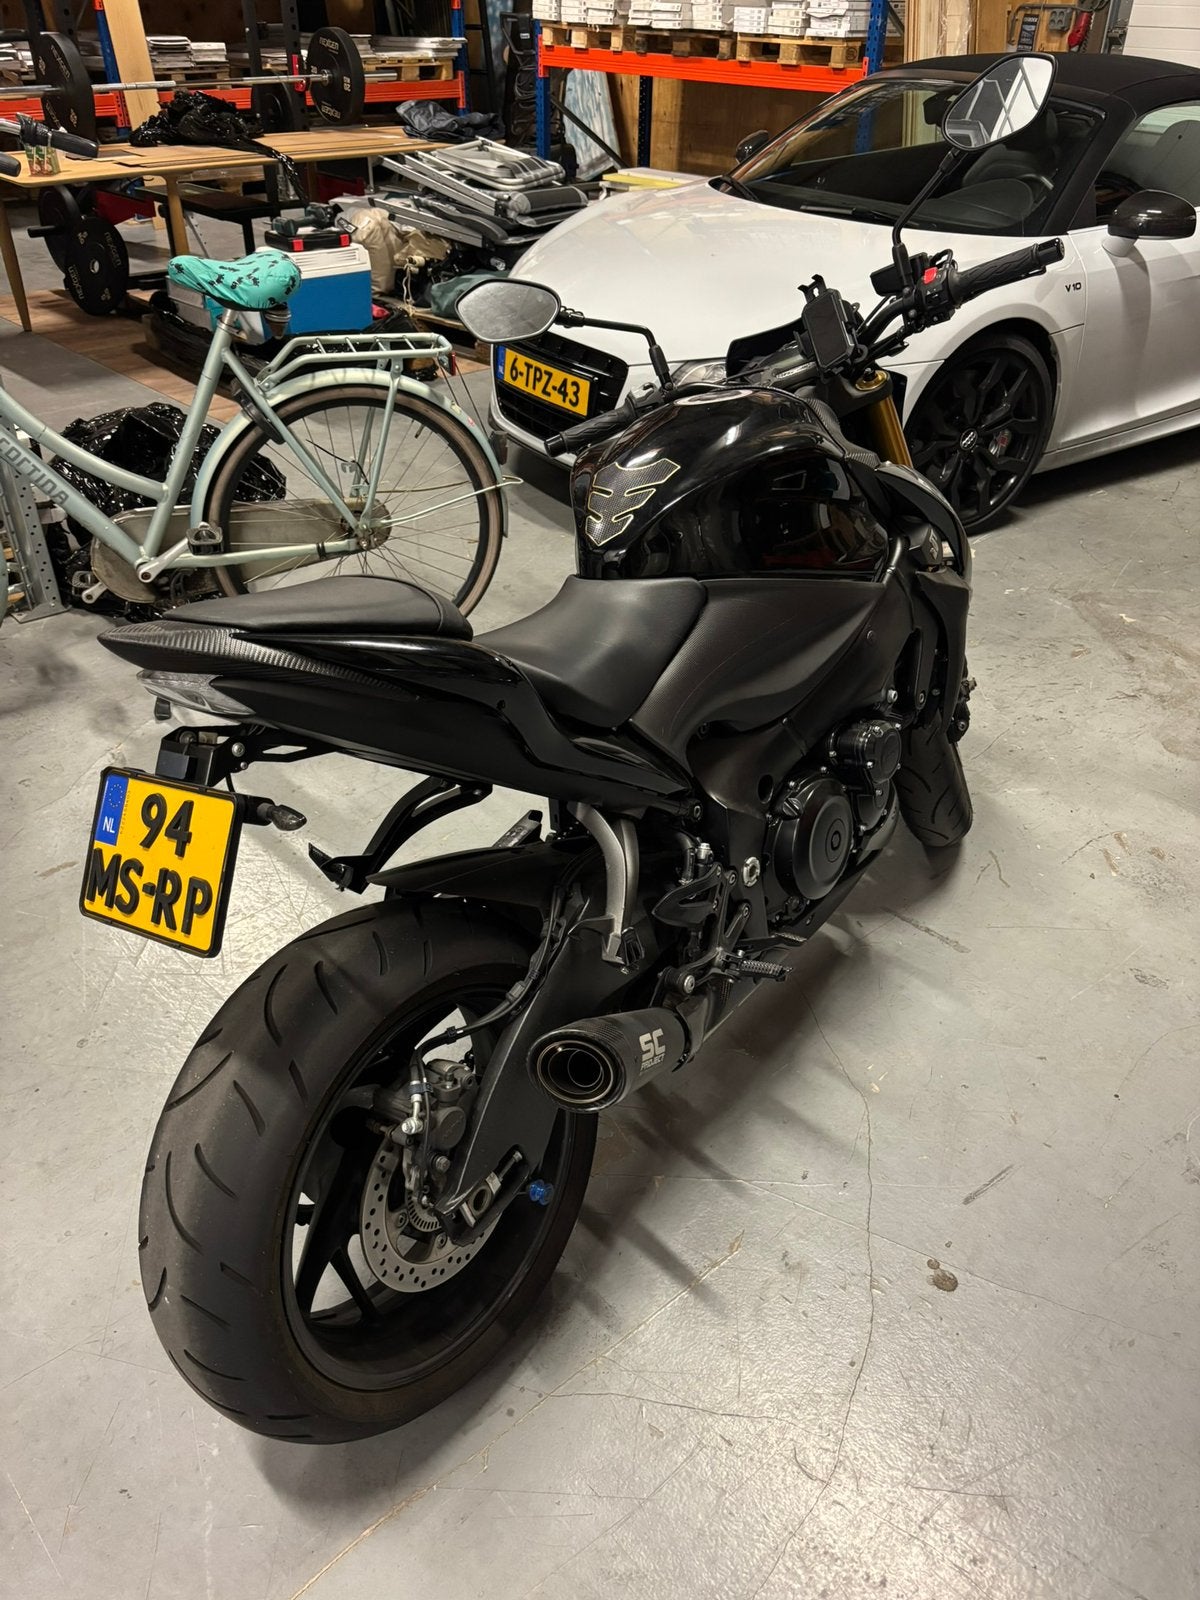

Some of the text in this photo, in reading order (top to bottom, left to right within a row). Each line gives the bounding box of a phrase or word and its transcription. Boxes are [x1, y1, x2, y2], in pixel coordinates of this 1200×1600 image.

[1064, 281, 1082, 292] V10
[510, 357, 580, 408] 6-TPZ-43
[103, 815, 116, 834] NL
[139, 792, 195, 859] 94
[86, 847, 213, 936] MS-RP
[639, 1028, 666, 1062] SC
